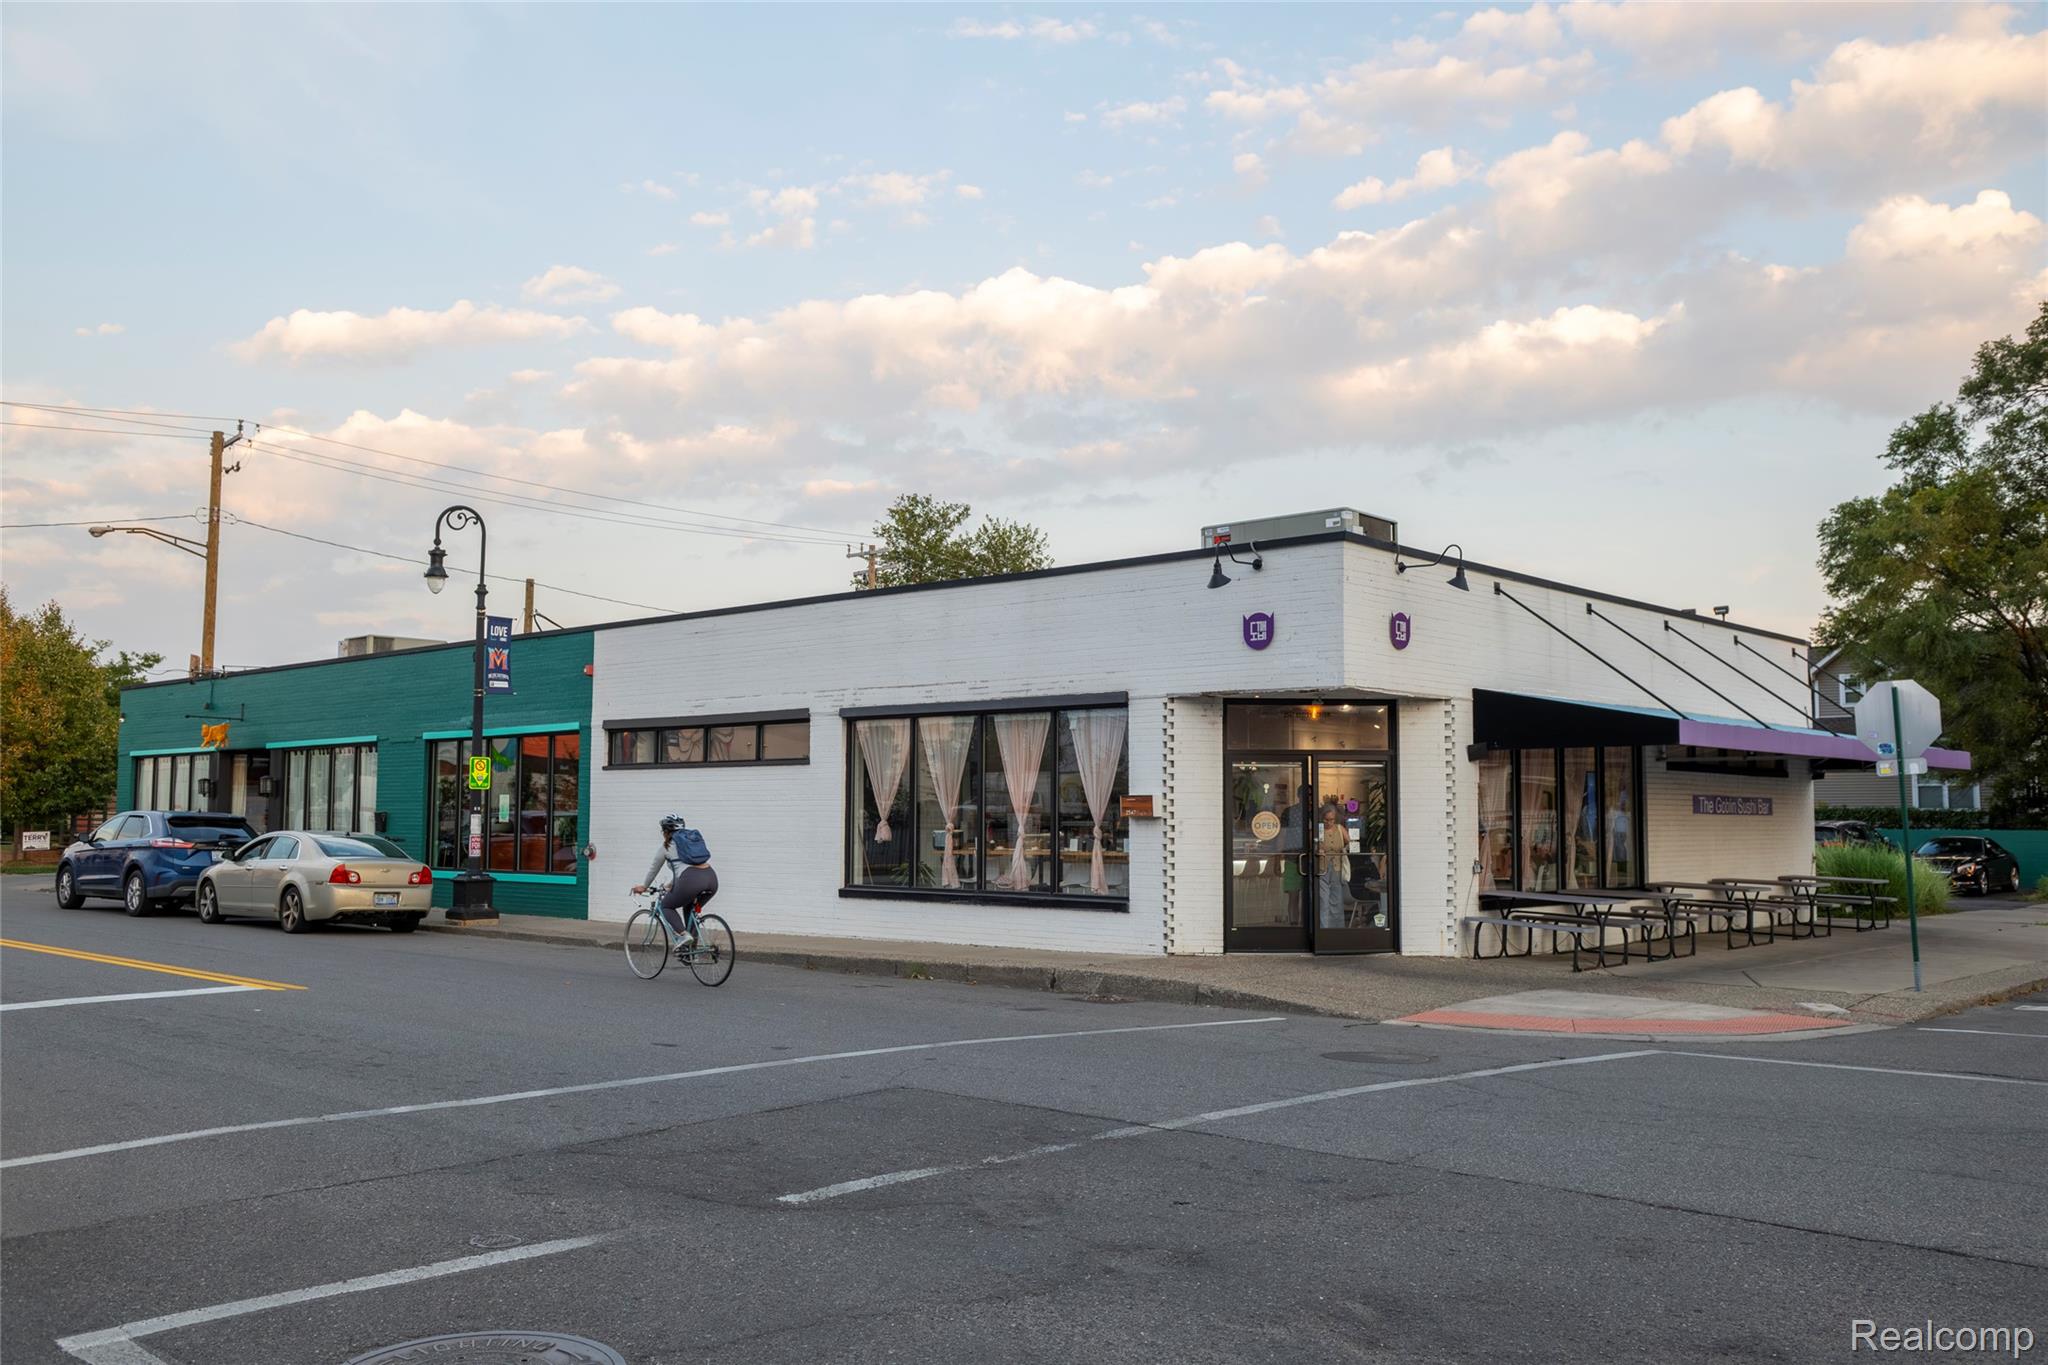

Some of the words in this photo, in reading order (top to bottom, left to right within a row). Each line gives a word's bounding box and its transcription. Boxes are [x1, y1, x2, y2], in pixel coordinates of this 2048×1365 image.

[490, 625, 508, 637] LOVE
[1698, 796, 1714, 813] The
[1715, 797, 1737, 814] Goblin
[1737, 798, 1757, 814] Sushi
[1758, 799, 1770, 815] Bar
[1254, 821, 1278, 830] OPEN
